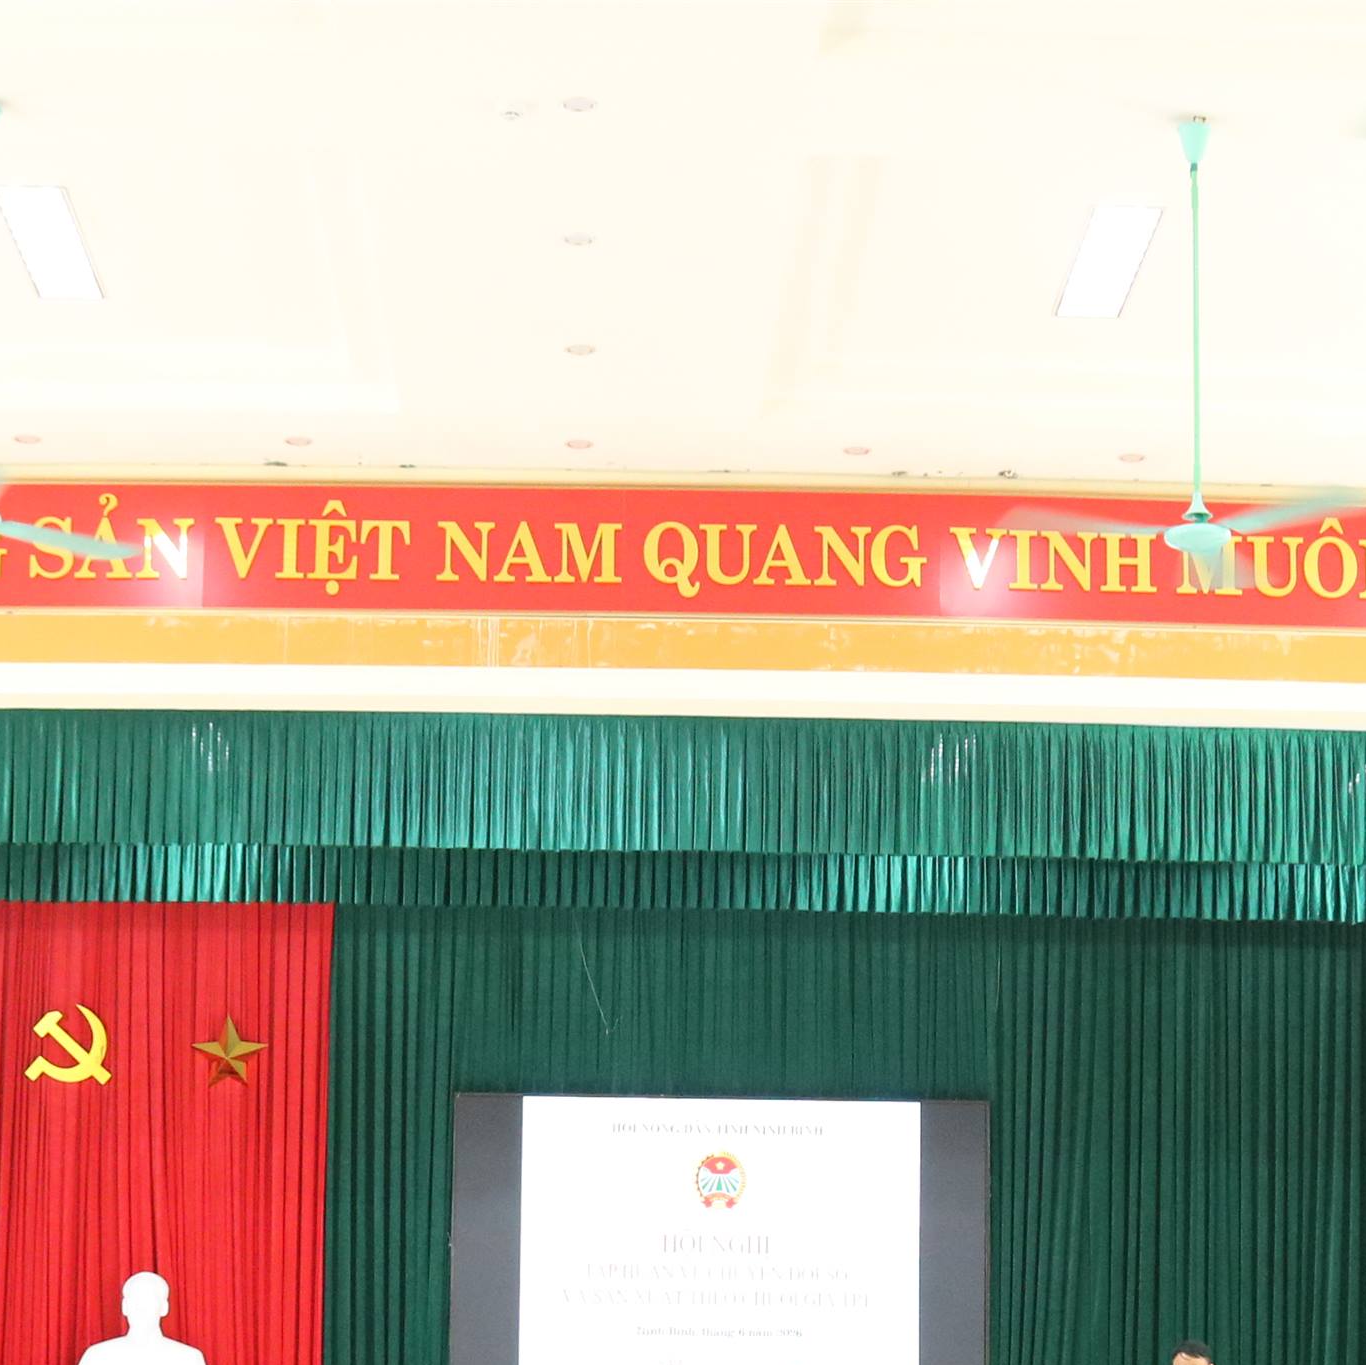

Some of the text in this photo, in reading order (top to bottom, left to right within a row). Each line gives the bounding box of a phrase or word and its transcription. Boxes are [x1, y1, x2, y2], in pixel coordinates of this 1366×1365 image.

[28, 493, 190, 582] SẢN
[215, 499, 411, 595] VIỆT
[435, 520, 623, 584] NAM
[642, 520, 927, 598] QUANG
[949, 526, 1159, 594] VINH
